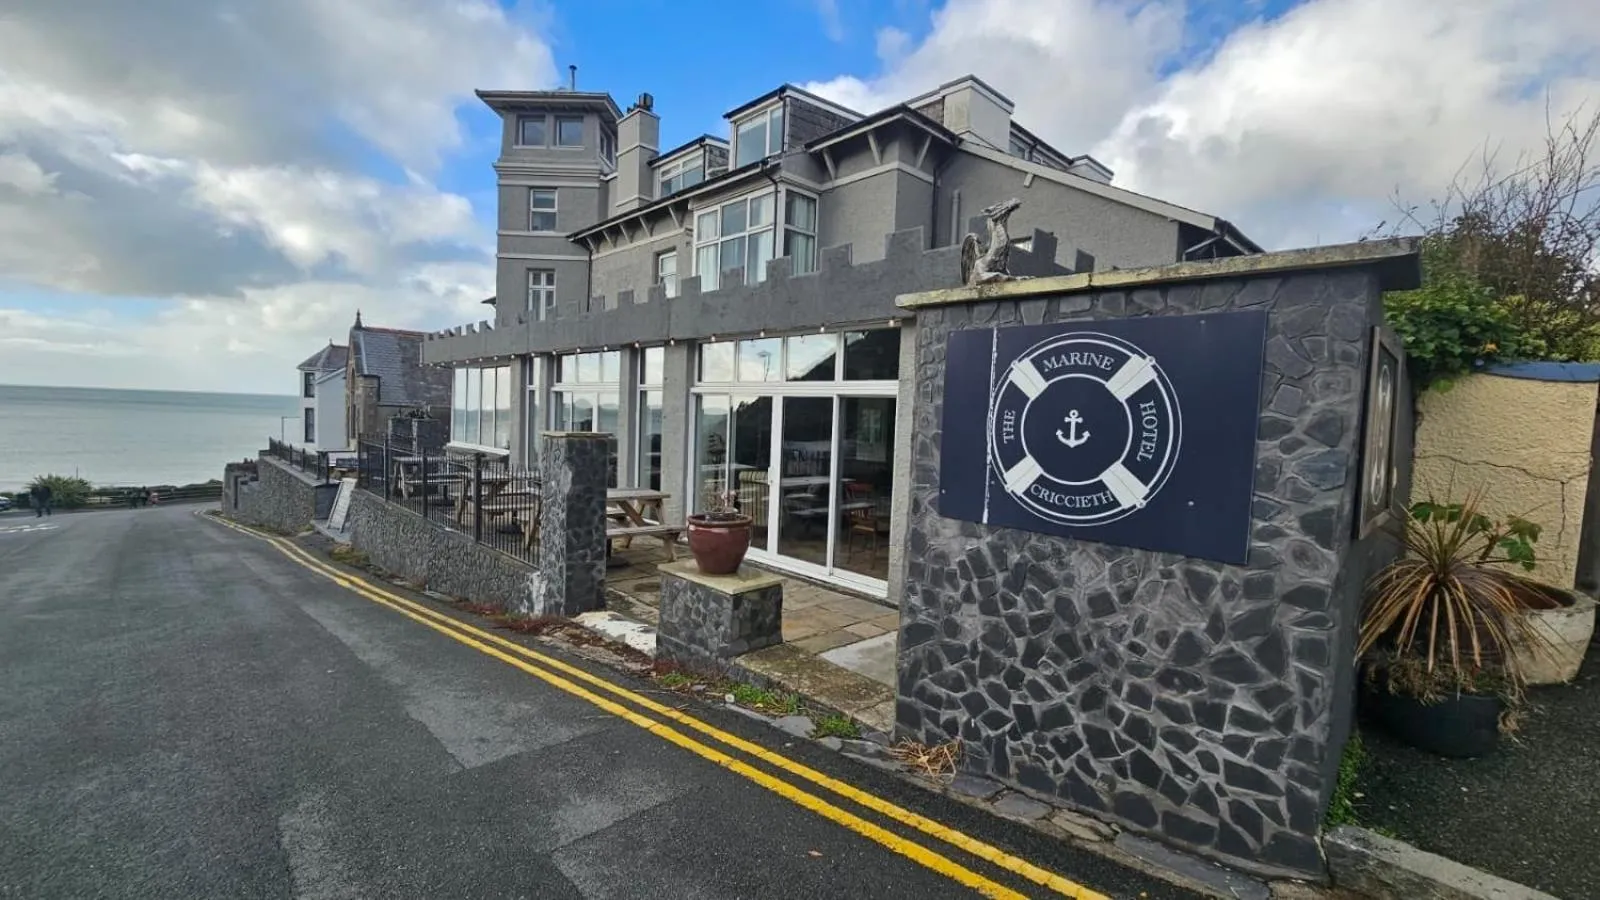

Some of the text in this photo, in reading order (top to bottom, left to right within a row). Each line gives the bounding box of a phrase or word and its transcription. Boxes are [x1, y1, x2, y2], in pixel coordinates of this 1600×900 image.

[1002, 351, 1158, 462] THE MARINE HOTEL
[1030, 483, 1114, 508] CRICCIETH
